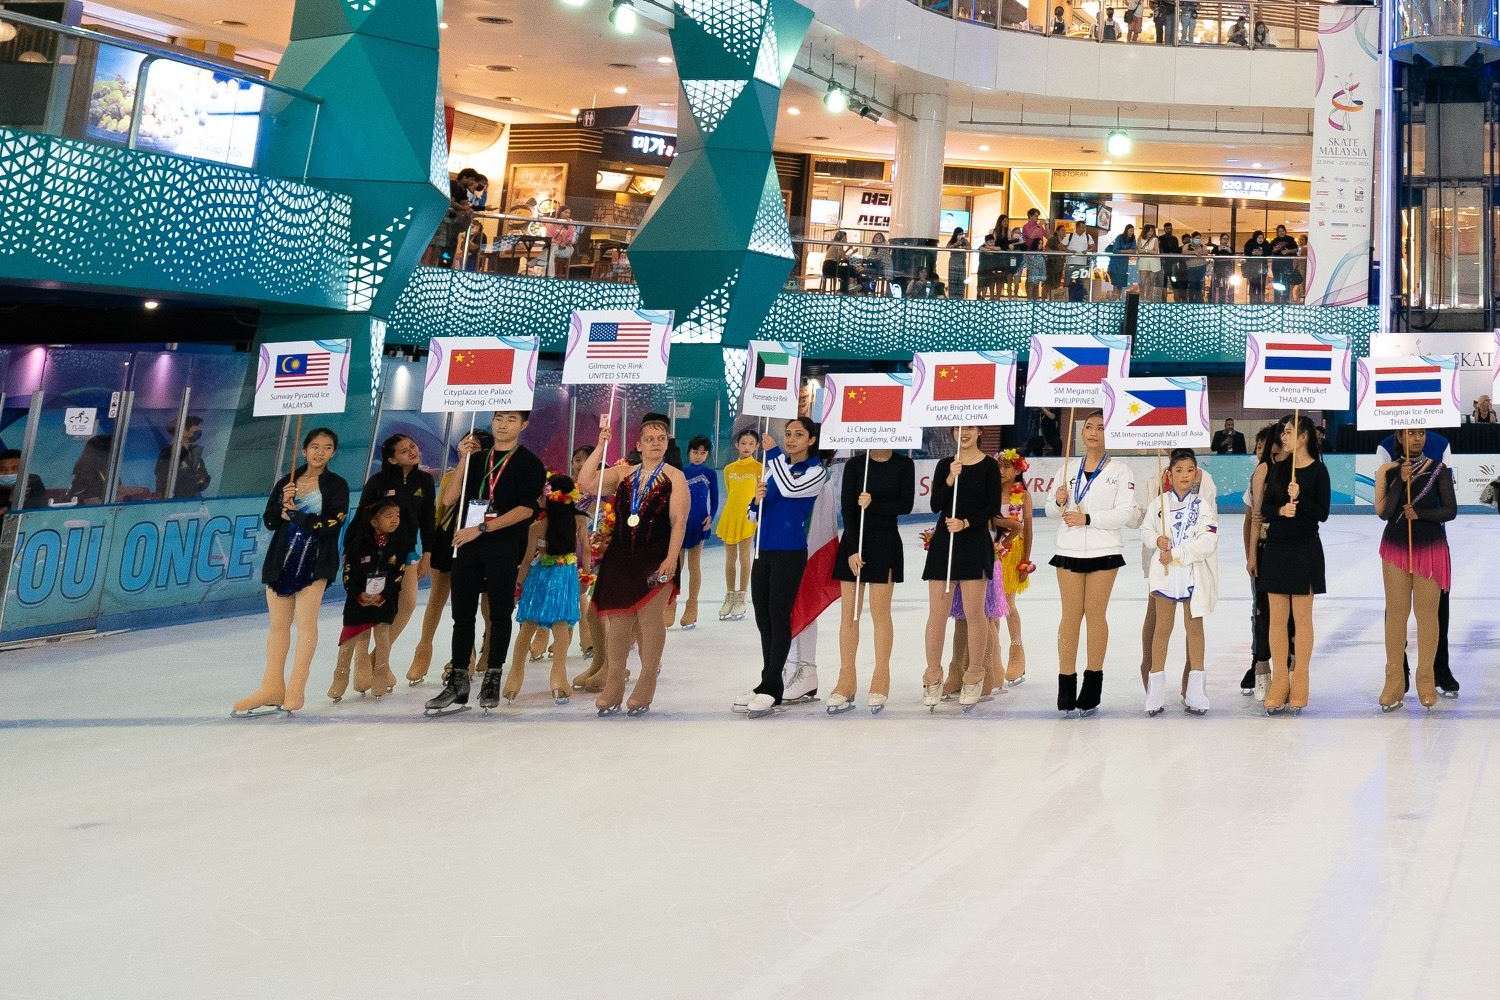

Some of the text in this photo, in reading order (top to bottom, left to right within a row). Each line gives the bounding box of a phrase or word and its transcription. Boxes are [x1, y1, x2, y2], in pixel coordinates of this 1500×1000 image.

[1329, 137, 1360, 147] SKATE
[1319, 146, 1368, 157] MALAYSIA
[1052, 170, 1089, 178] RESTORAN
[588, 372, 613, 380] UNITED
[443, 388, 514, 398] Cityplaza Ice Palace
[1053, 387, 1100, 397] SM Megamall
[1280, 386, 1302, 394] Arena
[1302, 386, 1328, 395] Phuket
[270, 393, 294, 402] Sunway
[294, 391, 320, 401] Pyramid
[1054, 397, 1096, 405] PHILIPPINES
[1278, 395, 1316, 405] THAILAND
[281, 401, 313, 410] MALAYSIA
[444, 397, 512, 408] Hong Kong, CHINA
[925, 402, 1000, 413] Future Bright Ice Rink
[936, 412, 988, 423] MACAU, CHINA
[1372, 407, 1445, 419] Chiangmai Ice Arena
[1390, 416, 1428, 427] THAILAND
[846, 425, 897, 435] Li Cheng Jiang
[1110, 431, 1121, 439] SM
[1165, 430, 1180, 438] Mall
[1181, 430, 1188, 438] of
[1188, 430, 1204, 438] Asia
[829, 435, 913, 446] Skating Academy, CHINA
[1136, 439, 1178, 448] PHILIPPINES
[118, 514, 263, 594] ONCE
